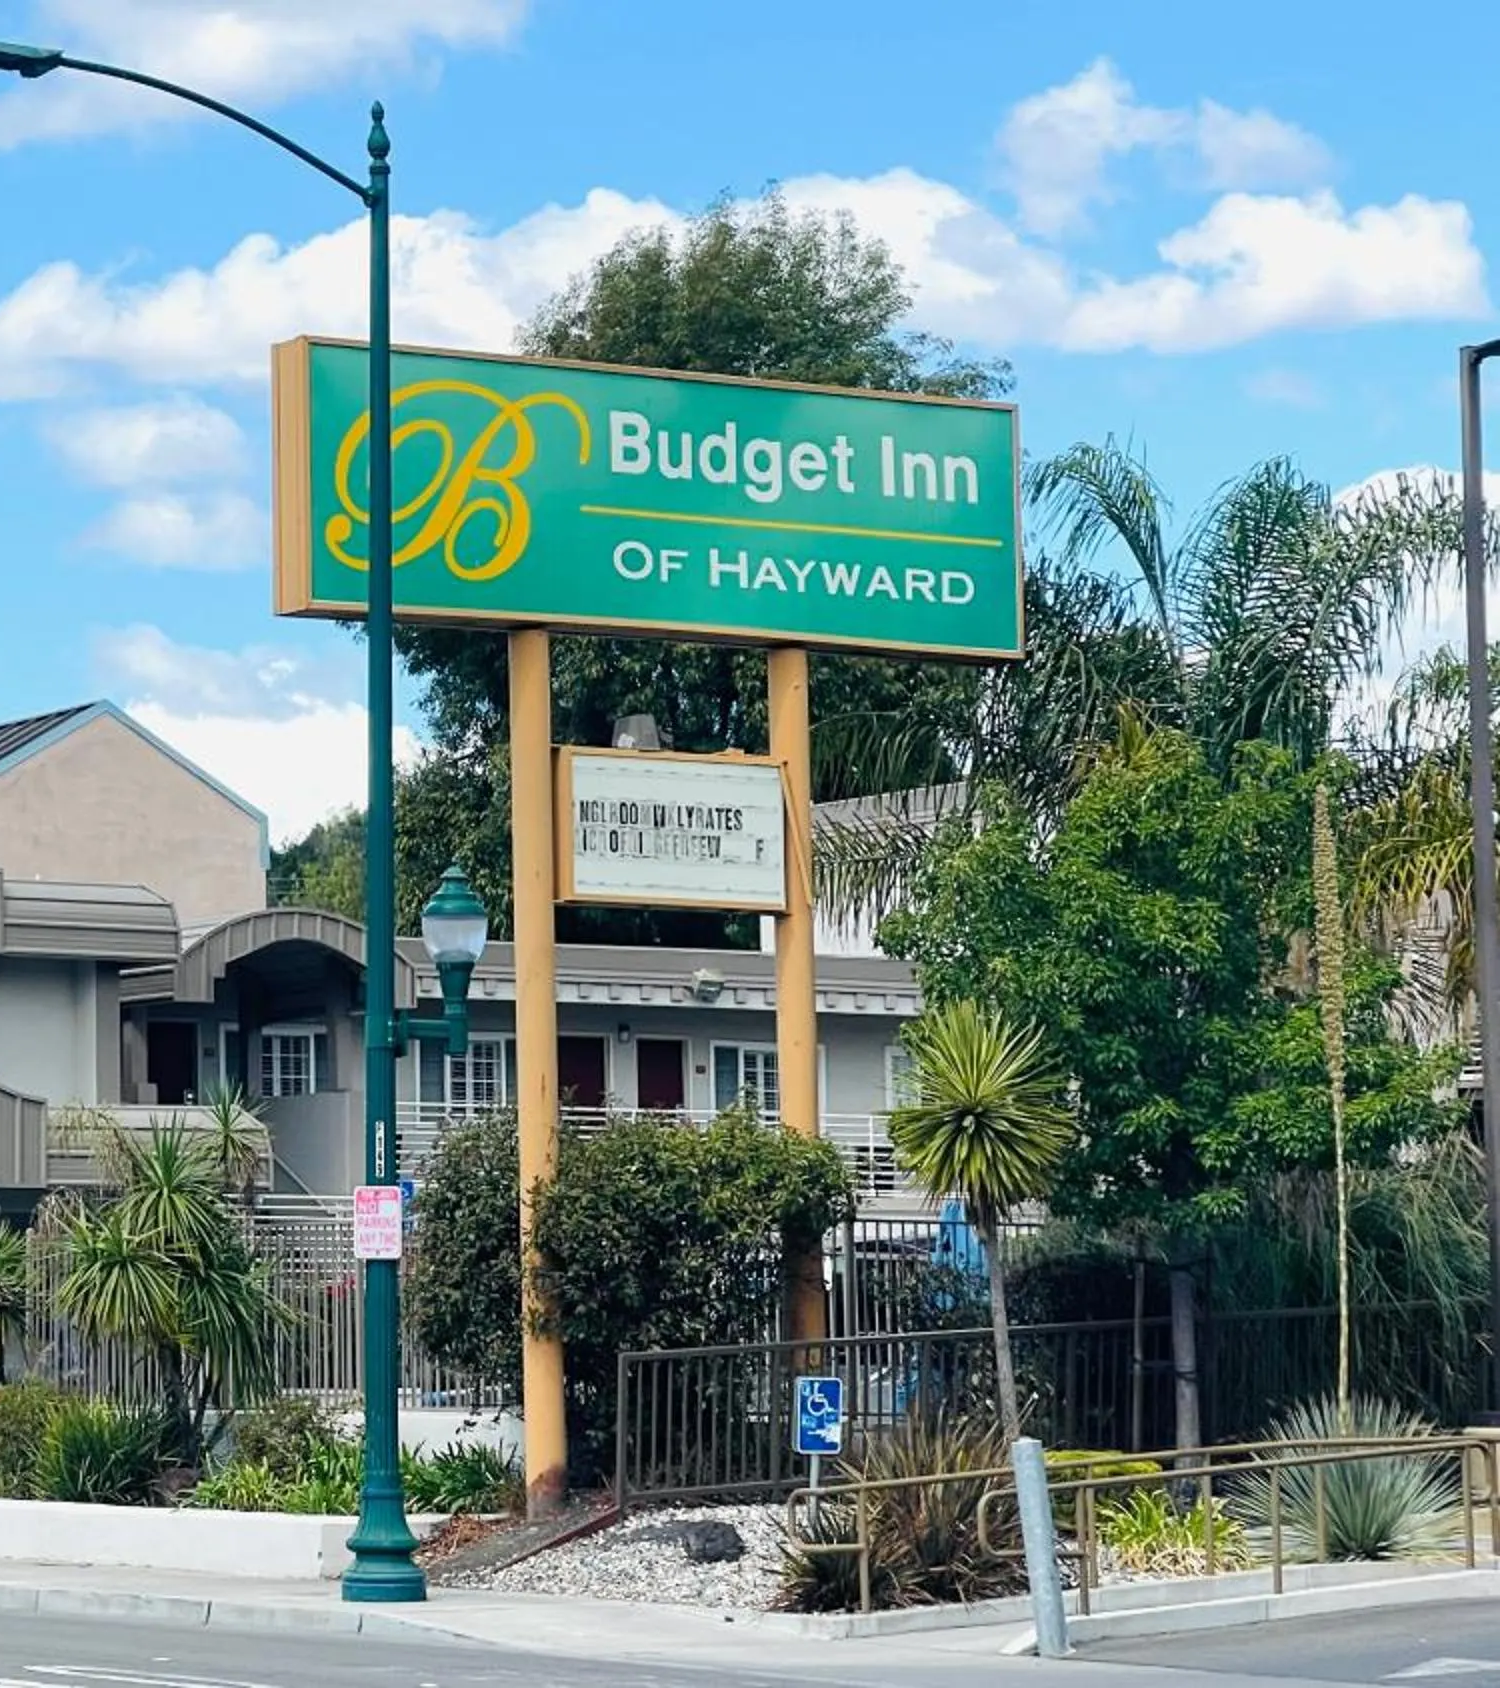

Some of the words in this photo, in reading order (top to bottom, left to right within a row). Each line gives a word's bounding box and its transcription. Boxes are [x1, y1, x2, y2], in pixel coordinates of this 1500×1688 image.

[609, 410, 855, 504] Budget
[881, 435, 979, 505] Inn
[612, 540, 690, 584] OF
[708, 547, 976, 605] HAYWARD
